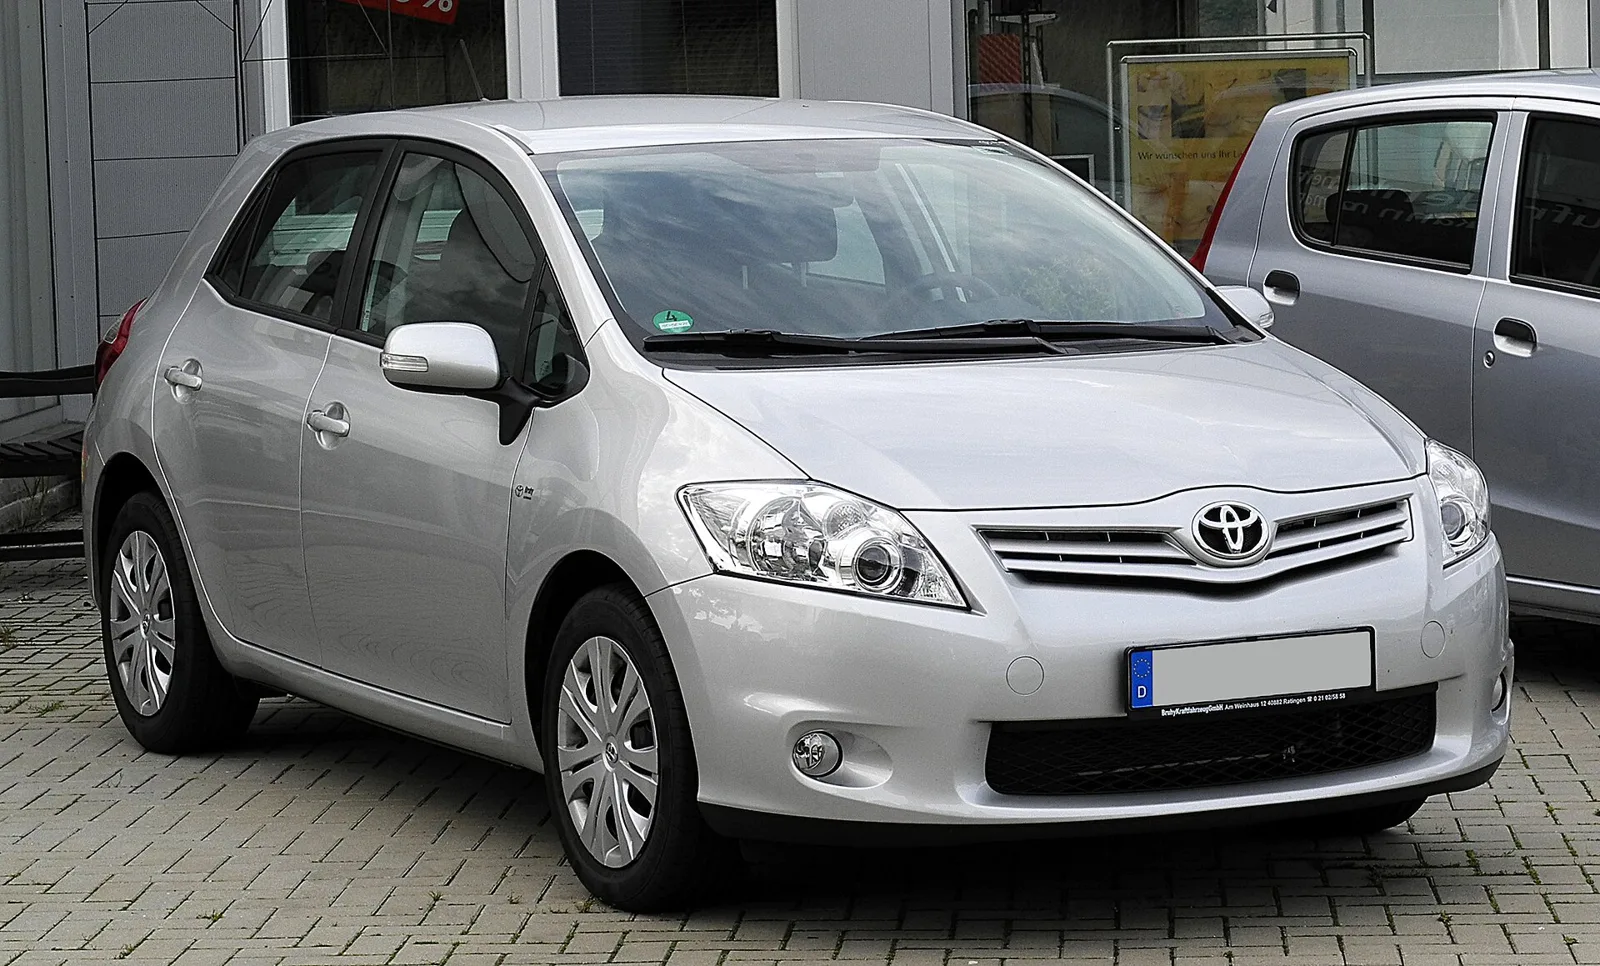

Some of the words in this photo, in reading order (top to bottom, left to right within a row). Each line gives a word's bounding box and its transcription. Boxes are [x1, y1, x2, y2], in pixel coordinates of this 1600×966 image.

[1137, 151, 1153, 160] Wir
[1201, 151, 1216, 159] uns
[1218, 149, 1232, 159] Ihr
[1137, 685, 1147, 699] D
[1283, 697, 1306, 705] Ratingen
